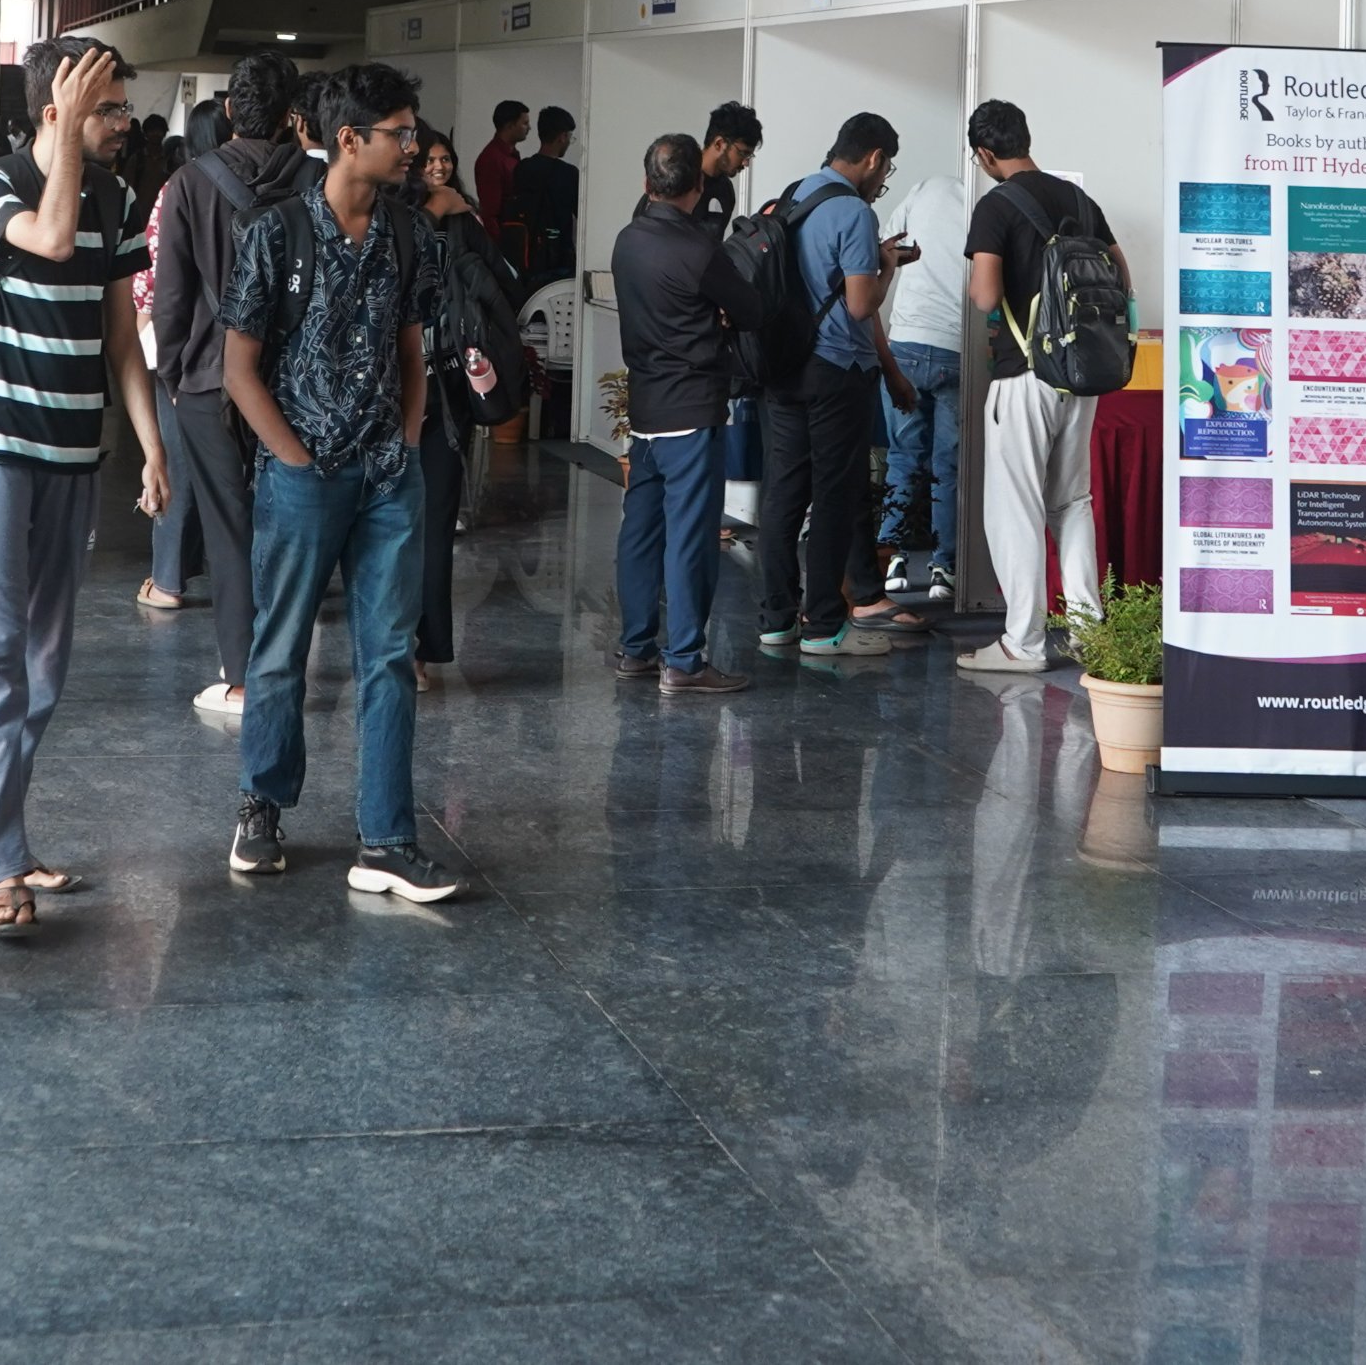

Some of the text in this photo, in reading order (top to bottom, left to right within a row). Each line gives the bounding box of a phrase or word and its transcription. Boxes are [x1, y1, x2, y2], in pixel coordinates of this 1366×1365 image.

[1239, 69, 1248, 121] ROUTLEDGE
[1286, 106, 1322, 121] Taylor
[1325, 108, 1335, 119] &
[1267, 134, 1311, 148] Books
[1316, 135, 1333, 151] by
[1245, 155, 1288, 171] from
[1293, 156, 1317, 172] IIT
[1303, 385, 1346, 393] ENCOUNTERING
[1197, 428, 1256, 436] REPRODUCTION
[1297, 491, 1361, 502] LiDAR Technology
[1297, 500, 1345, 510] for Intelligent
[1297, 510, 1349, 519] Transportation
[1297, 519, 1344, 527] Autonomous
